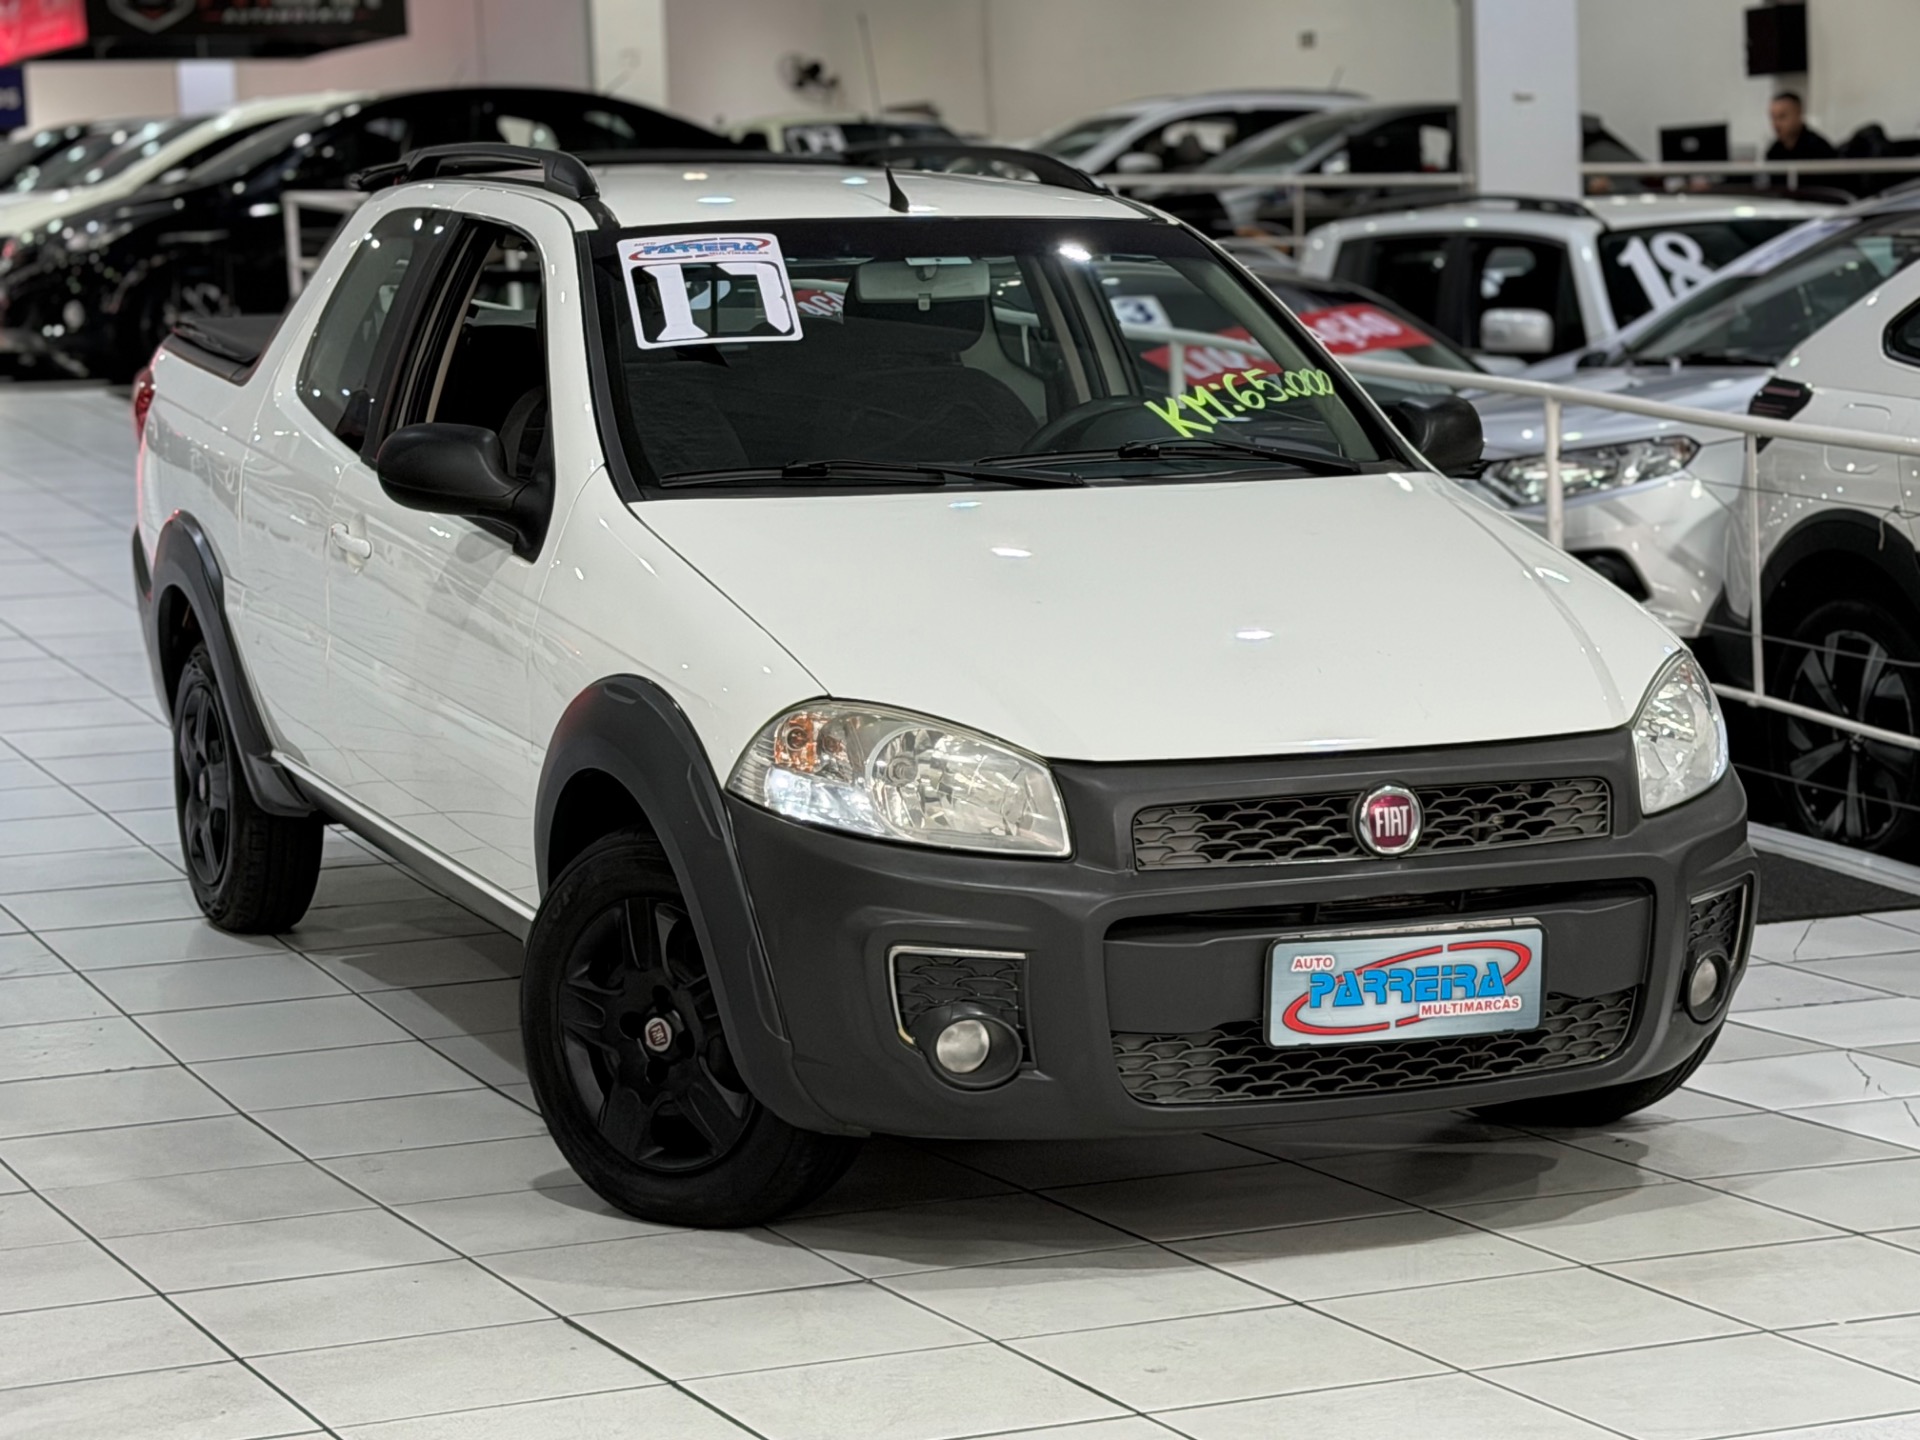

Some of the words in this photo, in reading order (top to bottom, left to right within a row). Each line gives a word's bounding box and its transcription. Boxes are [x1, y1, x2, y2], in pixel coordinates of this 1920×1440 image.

[643, 241, 760, 255] PARREIRA
[1616, 231, 1714, 310] 18
[1373, 805, 1410, 838] FIAT
[1292, 956, 1334, 970] AUTO
[1309, 961, 1507, 1009] PARREIRA
[1420, 997, 1521, 1016] MULTIMARCAS
